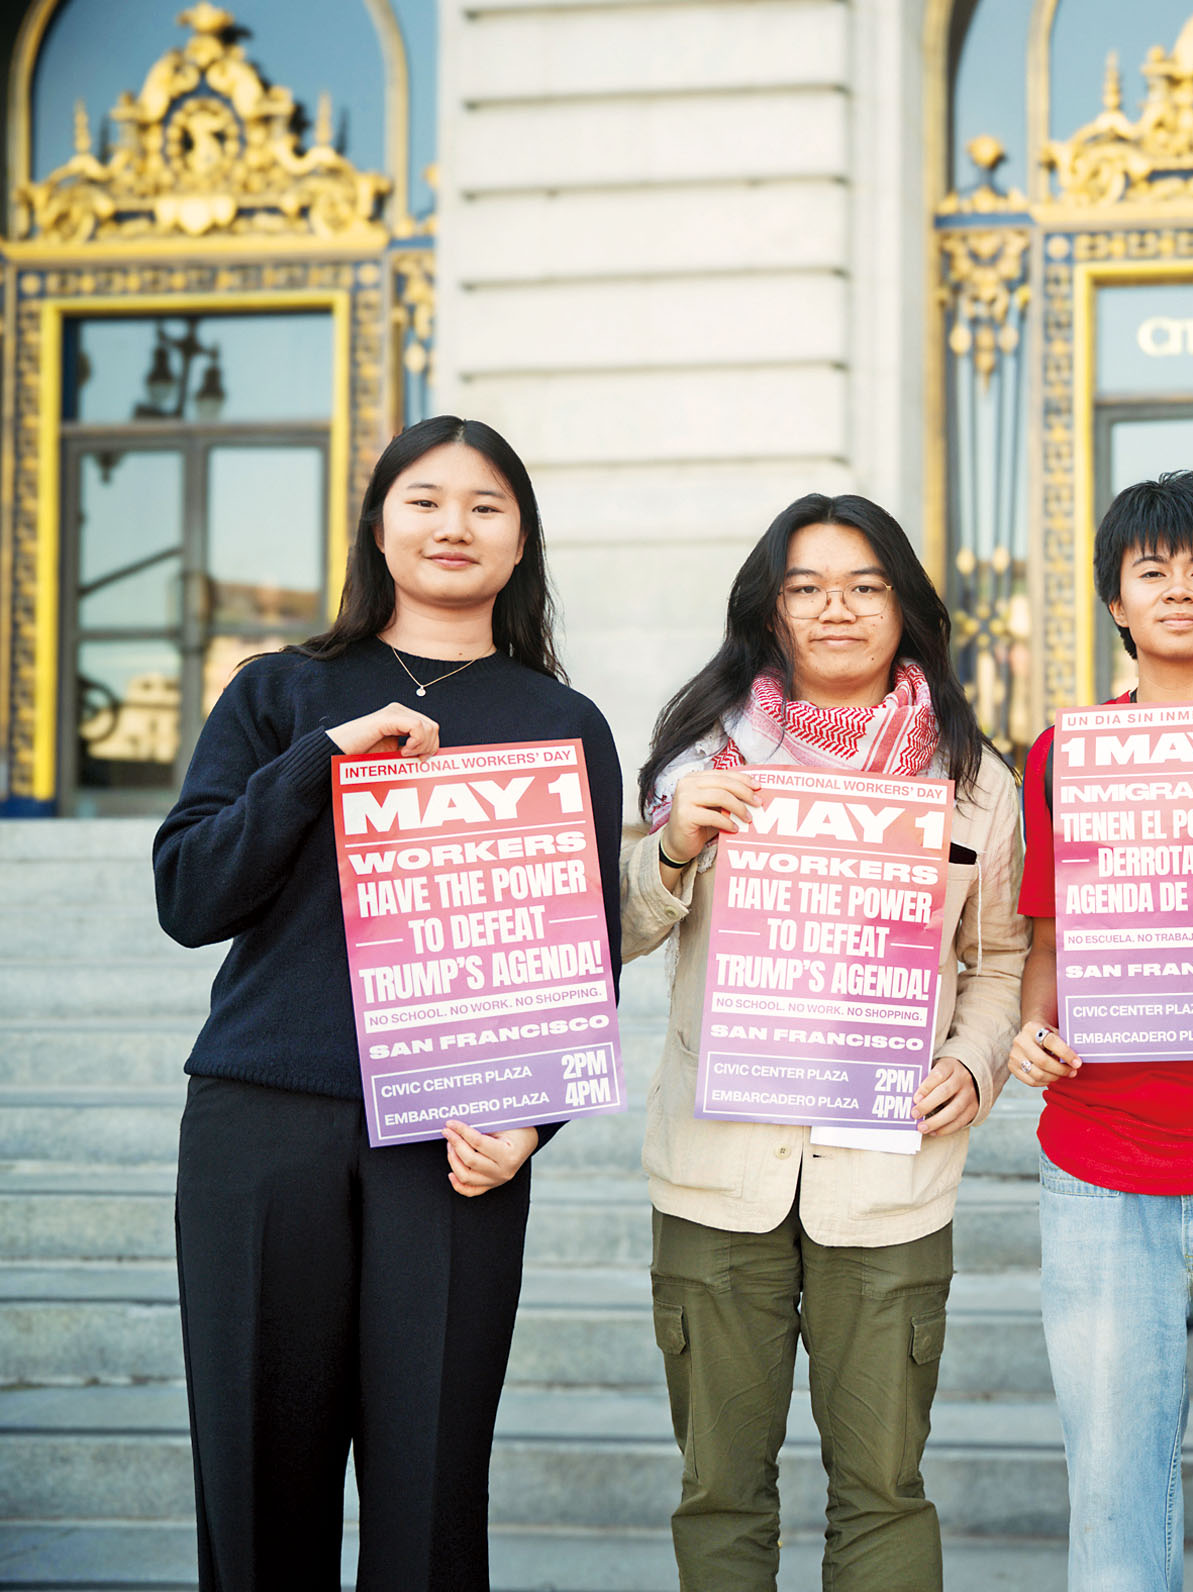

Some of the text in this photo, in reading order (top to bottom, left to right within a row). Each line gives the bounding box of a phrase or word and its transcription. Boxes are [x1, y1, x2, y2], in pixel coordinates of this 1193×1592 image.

[1068, 716, 1090, 726] UN
[1095, 713, 1122, 724] DIA
[1127, 711, 1153, 723] SIN
[345, 750, 572, 778] INTERNATIONAL WORKERS' DAY
[1061, 737, 1086, 767] 1
[750, 773, 943, 799] TERNATIONAL WORKERS' DAY
[342, 773, 584, 836] MAY 1
[731, 797, 945, 850] MAY 1
[1060, 810, 1135, 842] TIENEN
[1142, 809, 1167, 839] EL
[349, 831, 587, 875] WORKERS
[727, 849, 938, 885] WORKERS
[357, 859, 587, 918] HAVE THE POWER
[728, 876, 932, 924] HAVE THE POWER
[1065, 882, 1152, 915] AGENDA
[1160, 881, 1188, 912] DE
[408, 905, 546, 954] TO DEFEAT
[767, 918, 890, 958] TO DEFEAT
[1068, 935, 1083, 944] NO
[1085, 933, 1134, 943] ESCUELA.
[1138, 933, 1153, 942] NO
[359, 940, 604, 1003] TRUMP'S AGENDA!
[716, 954, 930, 1000] TRUMP'S AGENDA!
[1065, 964, 1122, 978] SAN
[369, 987, 602, 1027] NO SCHOOL. NO WORK. NO SHOPPING.
[716, 998, 922, 1021] NO SCHOOL. NO WORK. NO SHOPPING.
[1072, 1006, 1107, 1017] CIVIC
[1109, 1004, 1163, 1016] CENTER
[369, 1014, 610, 1060] SAN FRANCISCO
[711, 1025, 924, 1050] SAN FRANCISCO
[1073, 1031, 1177, 1043] EMBARCADERO
[381, 1049, 607, 1098] CIVIC CENTER PLAZA 2PM
[714, 1063, 915, 1093] CIVIC CENTER PLAZA 2PM
[384, 1077, 611, 1126] EMBARCADERO PLAZA 4PM
[712, 1090, 912, 1119] EMBARCADERO PLAZA 4PM
